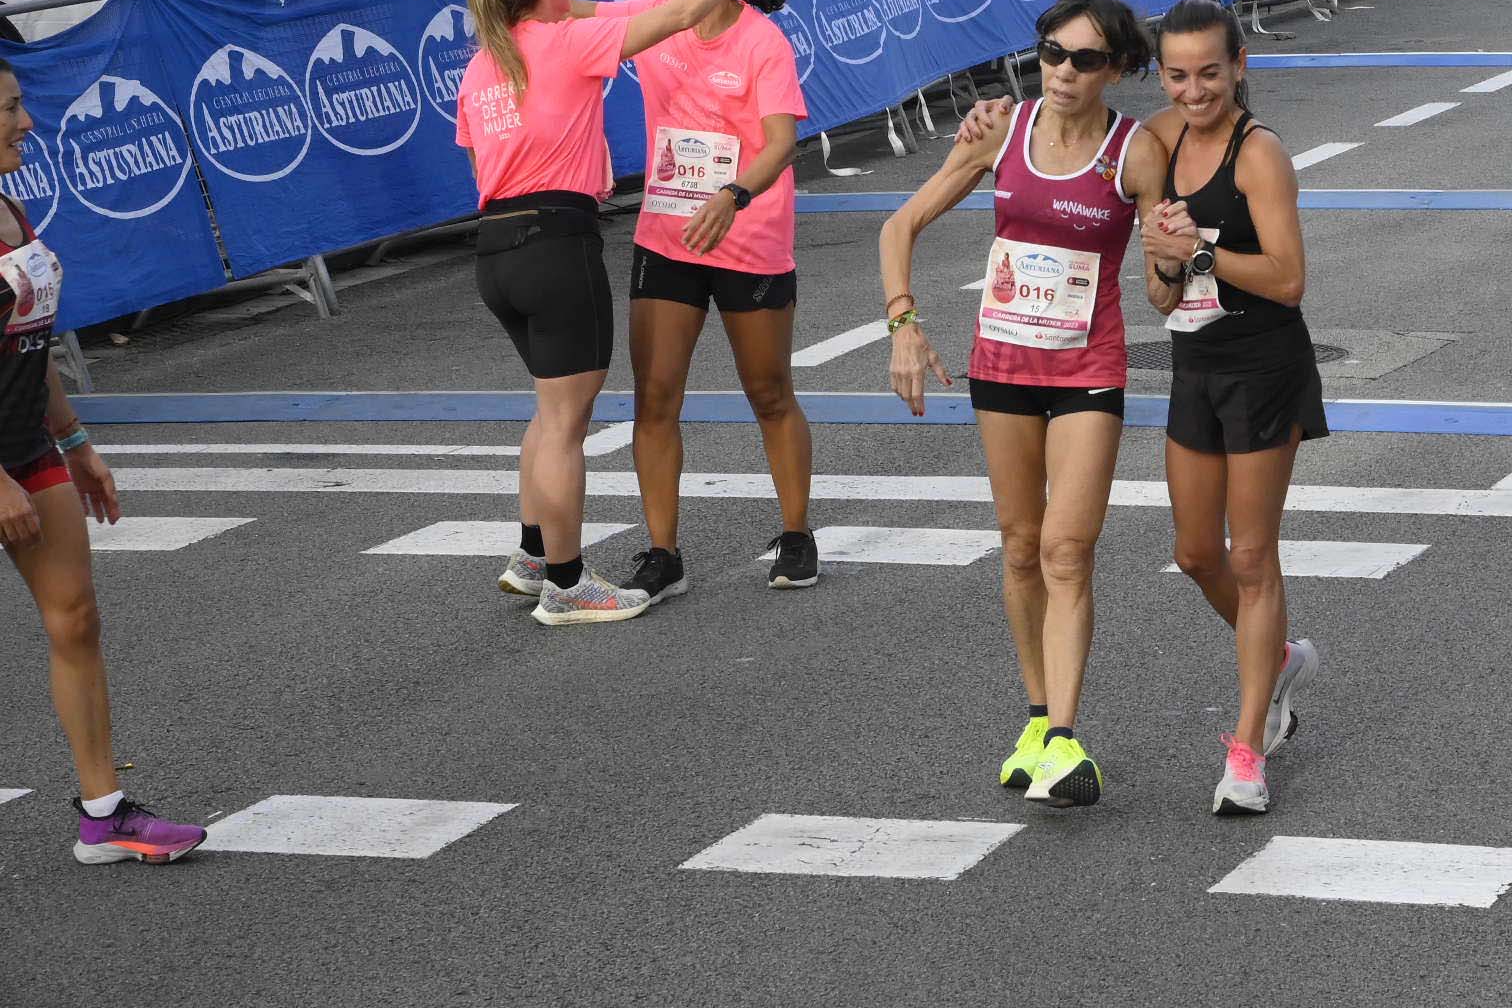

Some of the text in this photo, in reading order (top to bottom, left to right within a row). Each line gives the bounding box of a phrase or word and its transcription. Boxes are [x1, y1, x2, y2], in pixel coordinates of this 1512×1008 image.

[327, 62, 400, 86] CENTRAL LECHERA
[253, 85, 290, 103] LECHERA
[317, 79, 416, 129] ASTURIANA
[482, 99, 516, 119] DE LA
[202, 101, 306, 155] ASTURIANA
[483, 113, 523, 137] MUJER
[70, 131, 183, 192] ASTURIANA
[678, 164, 706, 178] 016
[1053, 198, 1112, 221] WANAWAKE
[1019, 284, 1056, 302] 016
